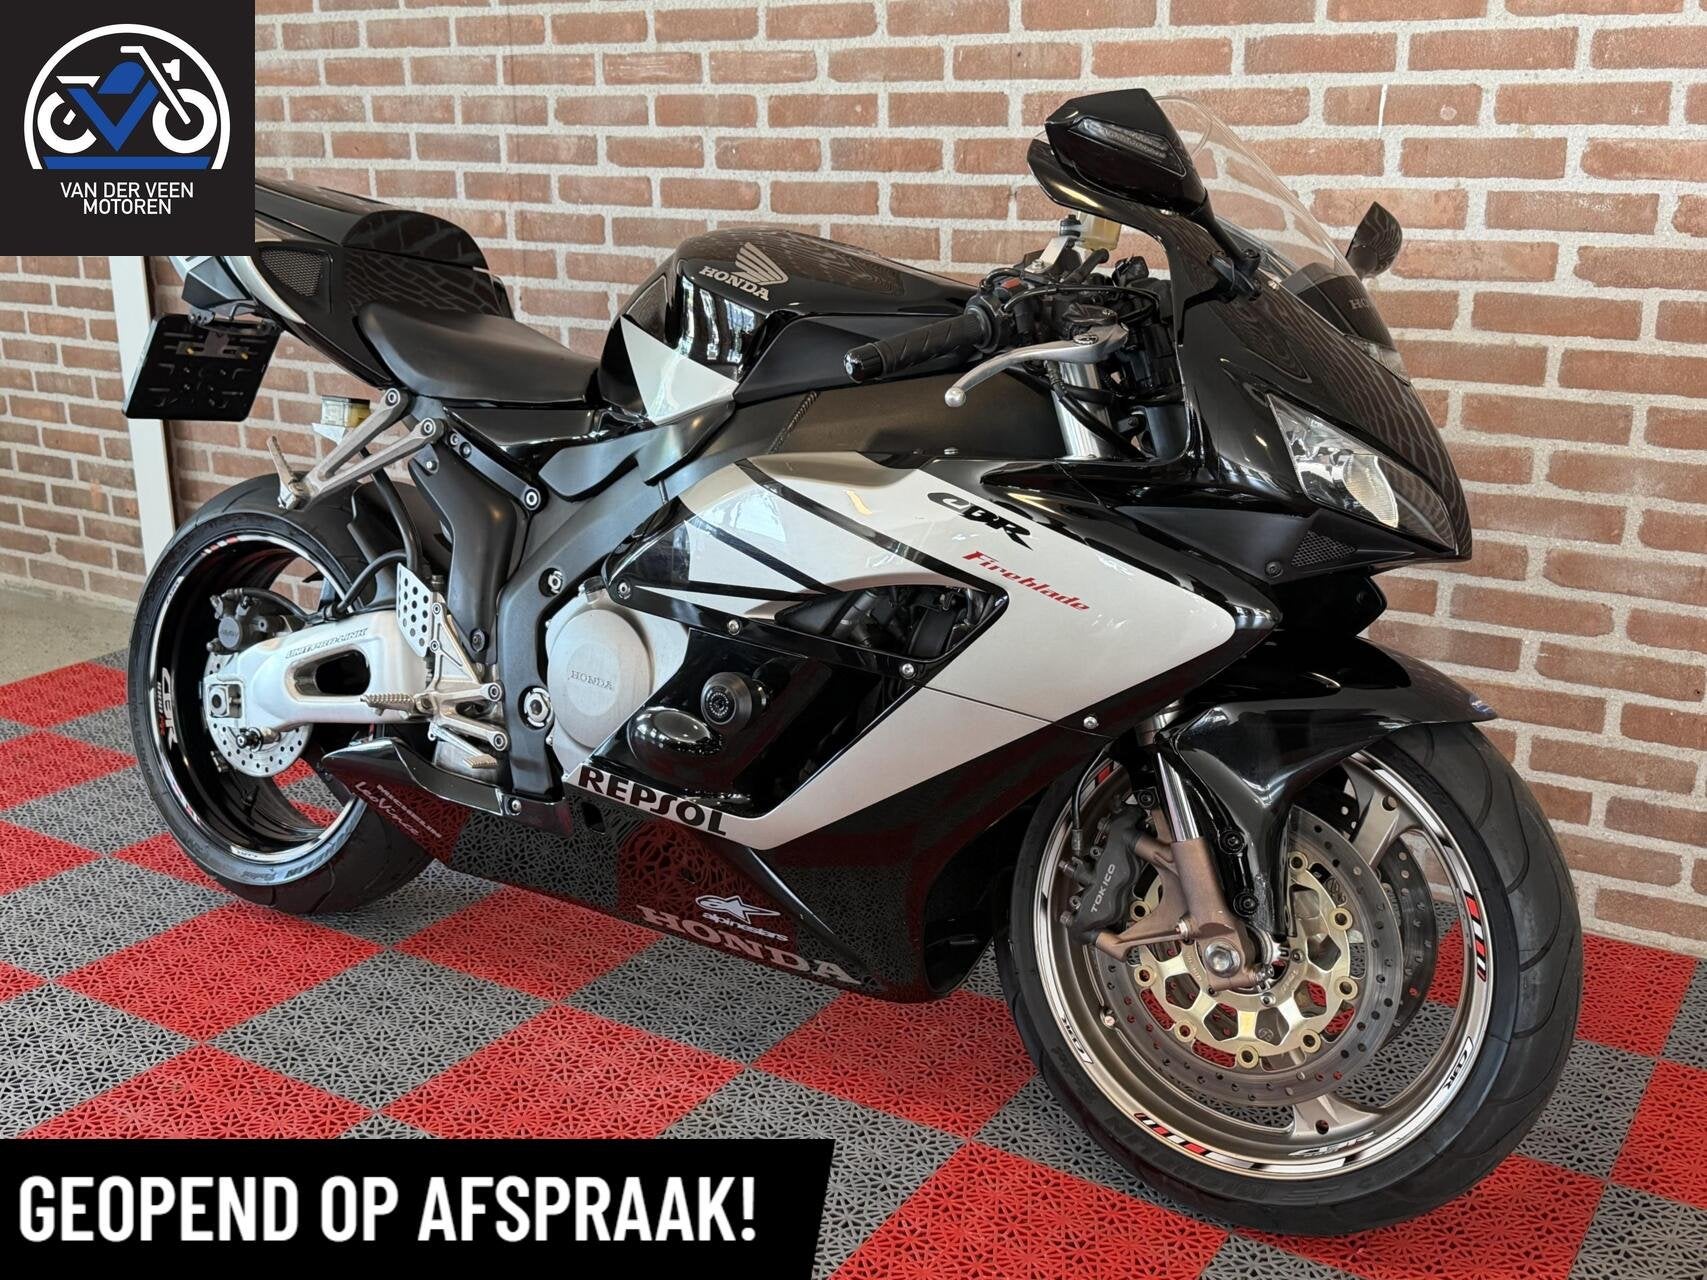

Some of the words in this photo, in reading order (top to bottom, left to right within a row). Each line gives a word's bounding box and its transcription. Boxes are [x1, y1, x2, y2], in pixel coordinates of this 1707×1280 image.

[699, 265, 769, 302] HONDA
[927, 492, 1034, 551] CBR
[962, 550, 1090, 612] Fireblade
[567, 669, 613, 691] HONDA
[578, 765, 727, 836] REPSOL
[1090, 863, 1116, 913] TOKICO
[636, 904, 862, 986] HONDA
[702, 911, 789, 943] alpinestars
